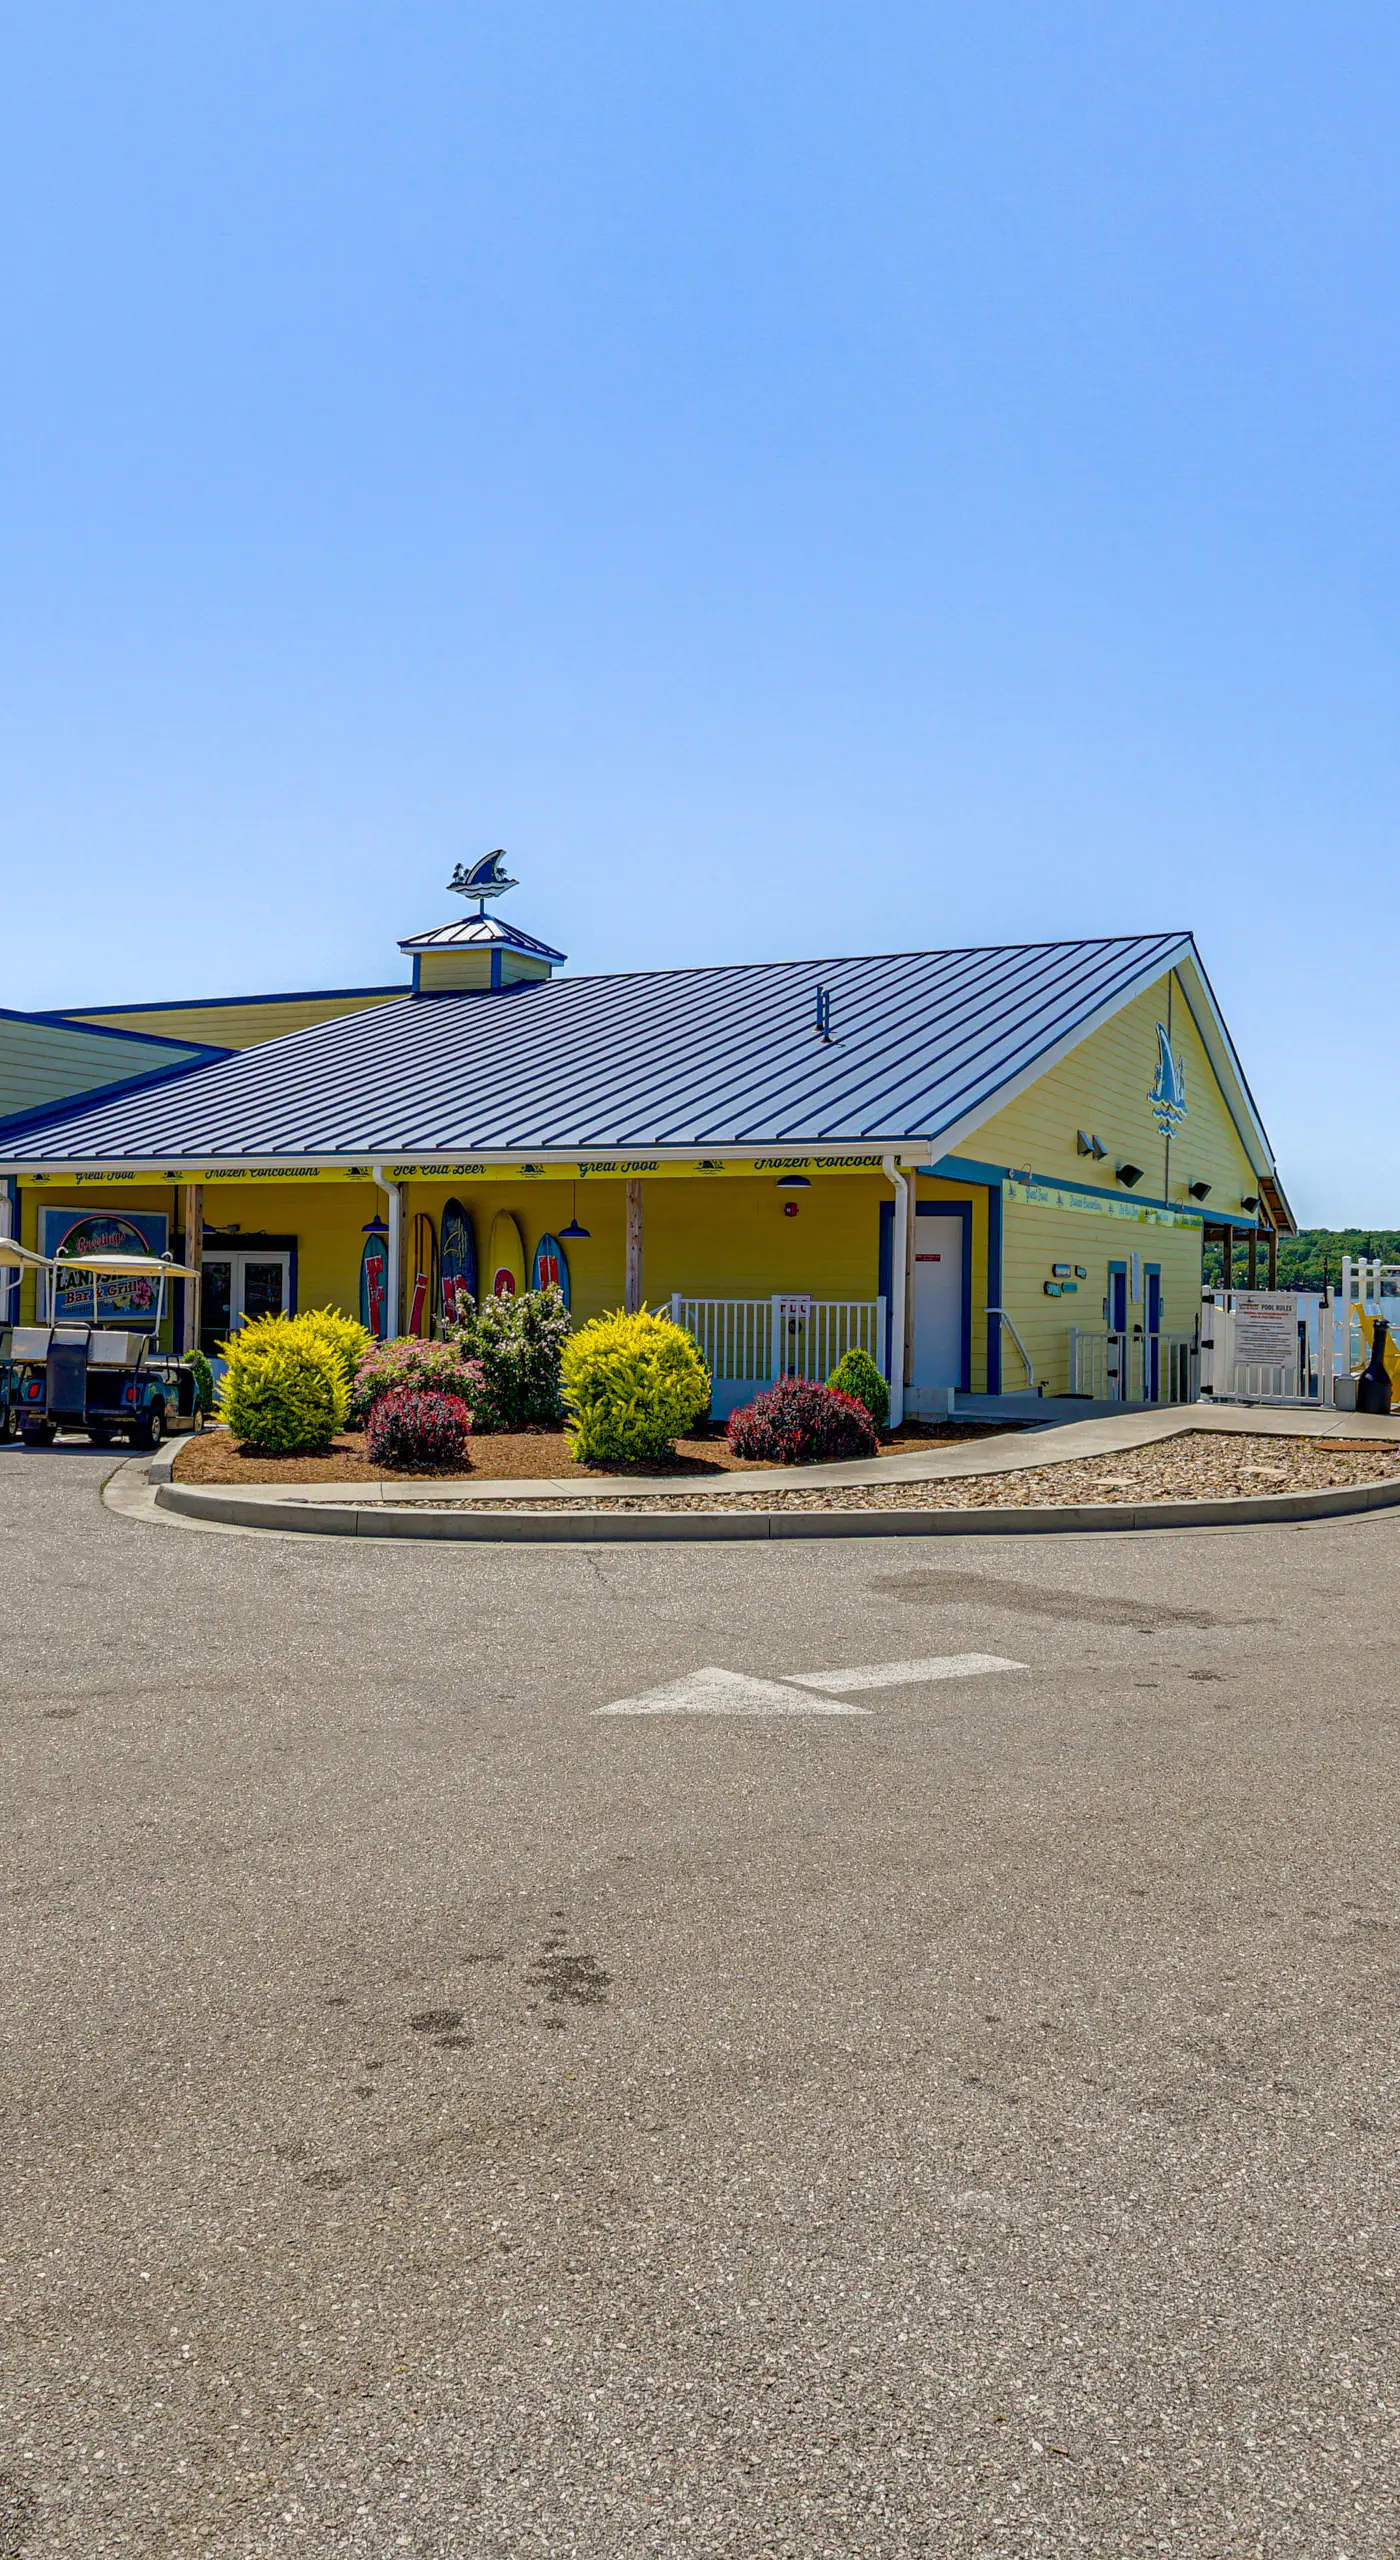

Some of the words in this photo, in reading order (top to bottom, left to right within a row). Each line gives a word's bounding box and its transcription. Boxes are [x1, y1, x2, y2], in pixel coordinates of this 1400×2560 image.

[393, 1164, 417, 1176] Ice
[420, 1164, 450, 1175] Cold
[452, 1163, 486, 1174] Beer
[577, 1161, 618, 1177] Great
[620, 1160, 659, 1172] Food
[754, 1156, 811, 1169] Frozen
[74, 1170, 105, 1185] Great
[106, 1170, 135, 1180] Food
[205, 1168, 247, 1179] Frozen
[249, 1166, 320, 1177] Concoctions
[65, 1291, 90, 1304] Bar
[107, 1281, 138, 1296] Grill
